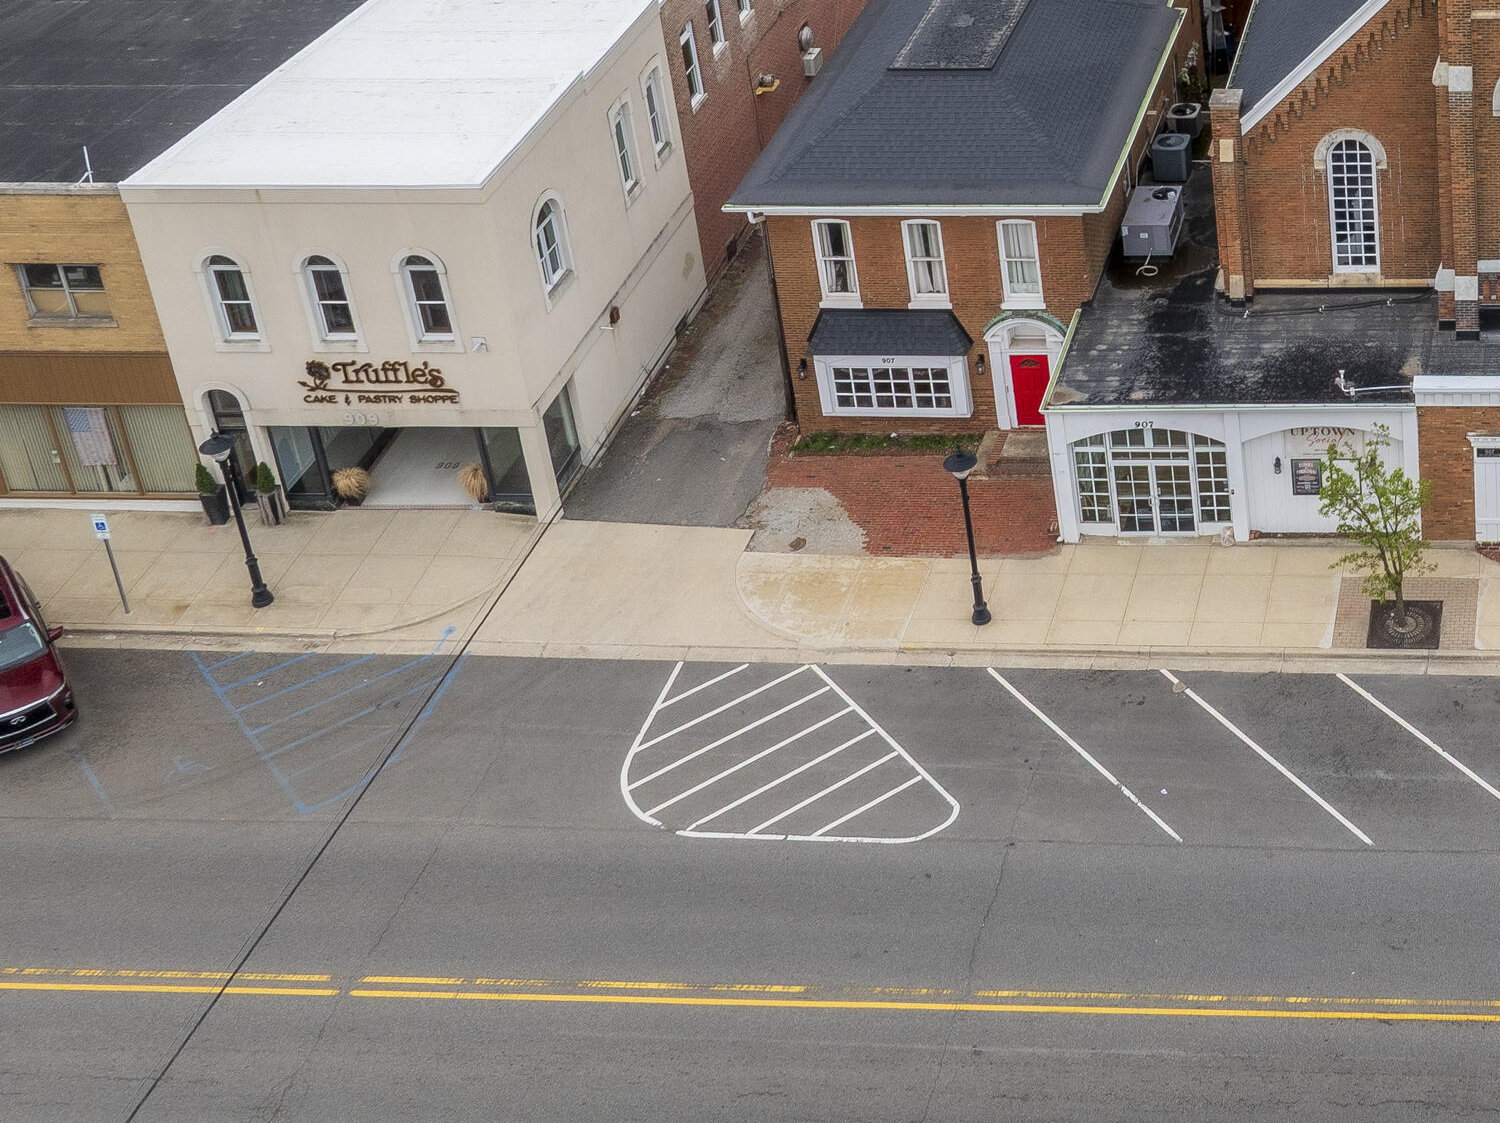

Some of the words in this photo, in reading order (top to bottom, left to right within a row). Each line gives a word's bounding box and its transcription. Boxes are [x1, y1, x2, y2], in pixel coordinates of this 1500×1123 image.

[331, 359, 446, 388] Truffle's
[303, 394, 339, 404] CAKE
[344, 394, 352, 406] &
[358, 394, 404, 404] PASTRY
[409, 394, 460, 404] SHOPPE
[343, 411, 380, 426] 909
[1134, 420, 1154, 428] 907
[1290, 427, 1356, 436] UPTOWN
[435, 460, 462, 469] 909
